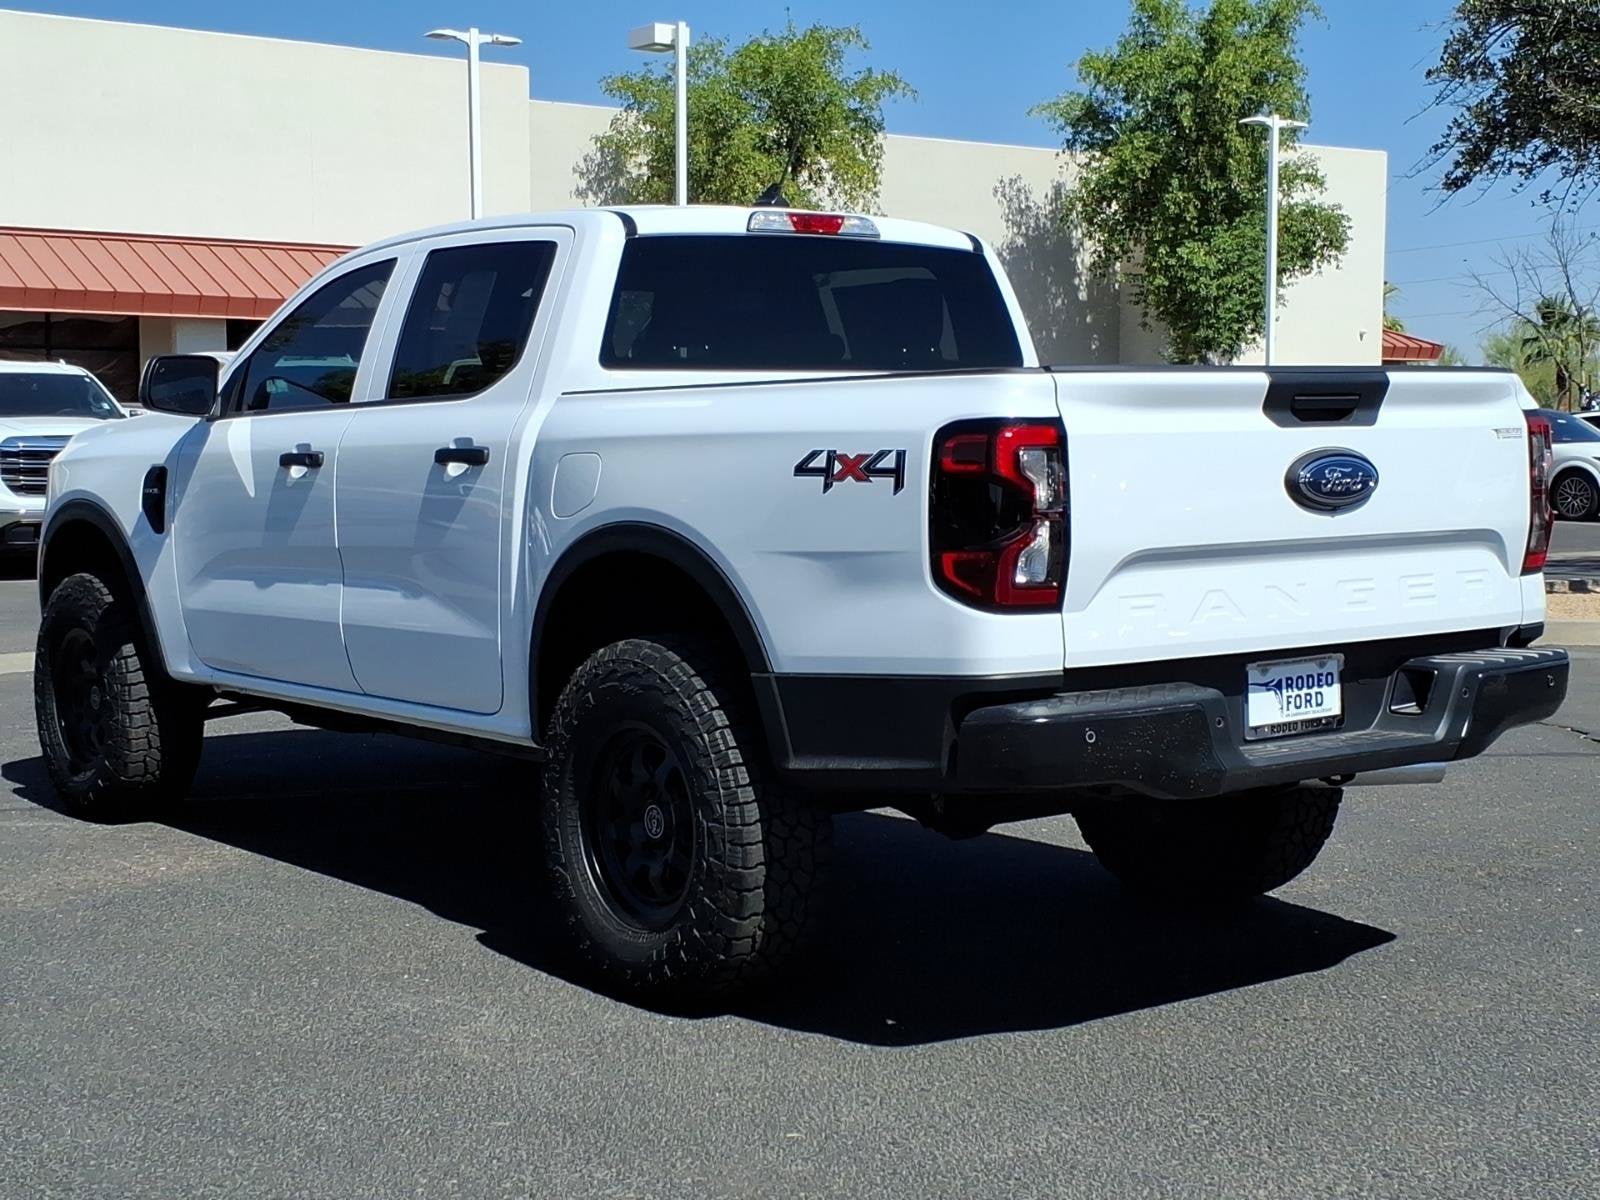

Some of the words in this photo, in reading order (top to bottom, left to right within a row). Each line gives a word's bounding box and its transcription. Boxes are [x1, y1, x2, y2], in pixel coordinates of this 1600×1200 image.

[1320, 466, 1363, 493] Ford
[1117, 568, 1491, 637] RANGER
[1285, 672, 1334, 693] RODEO
[1286, 691, 1324, 711] FORD
[1270, 722, 1298, 735] RODEO
